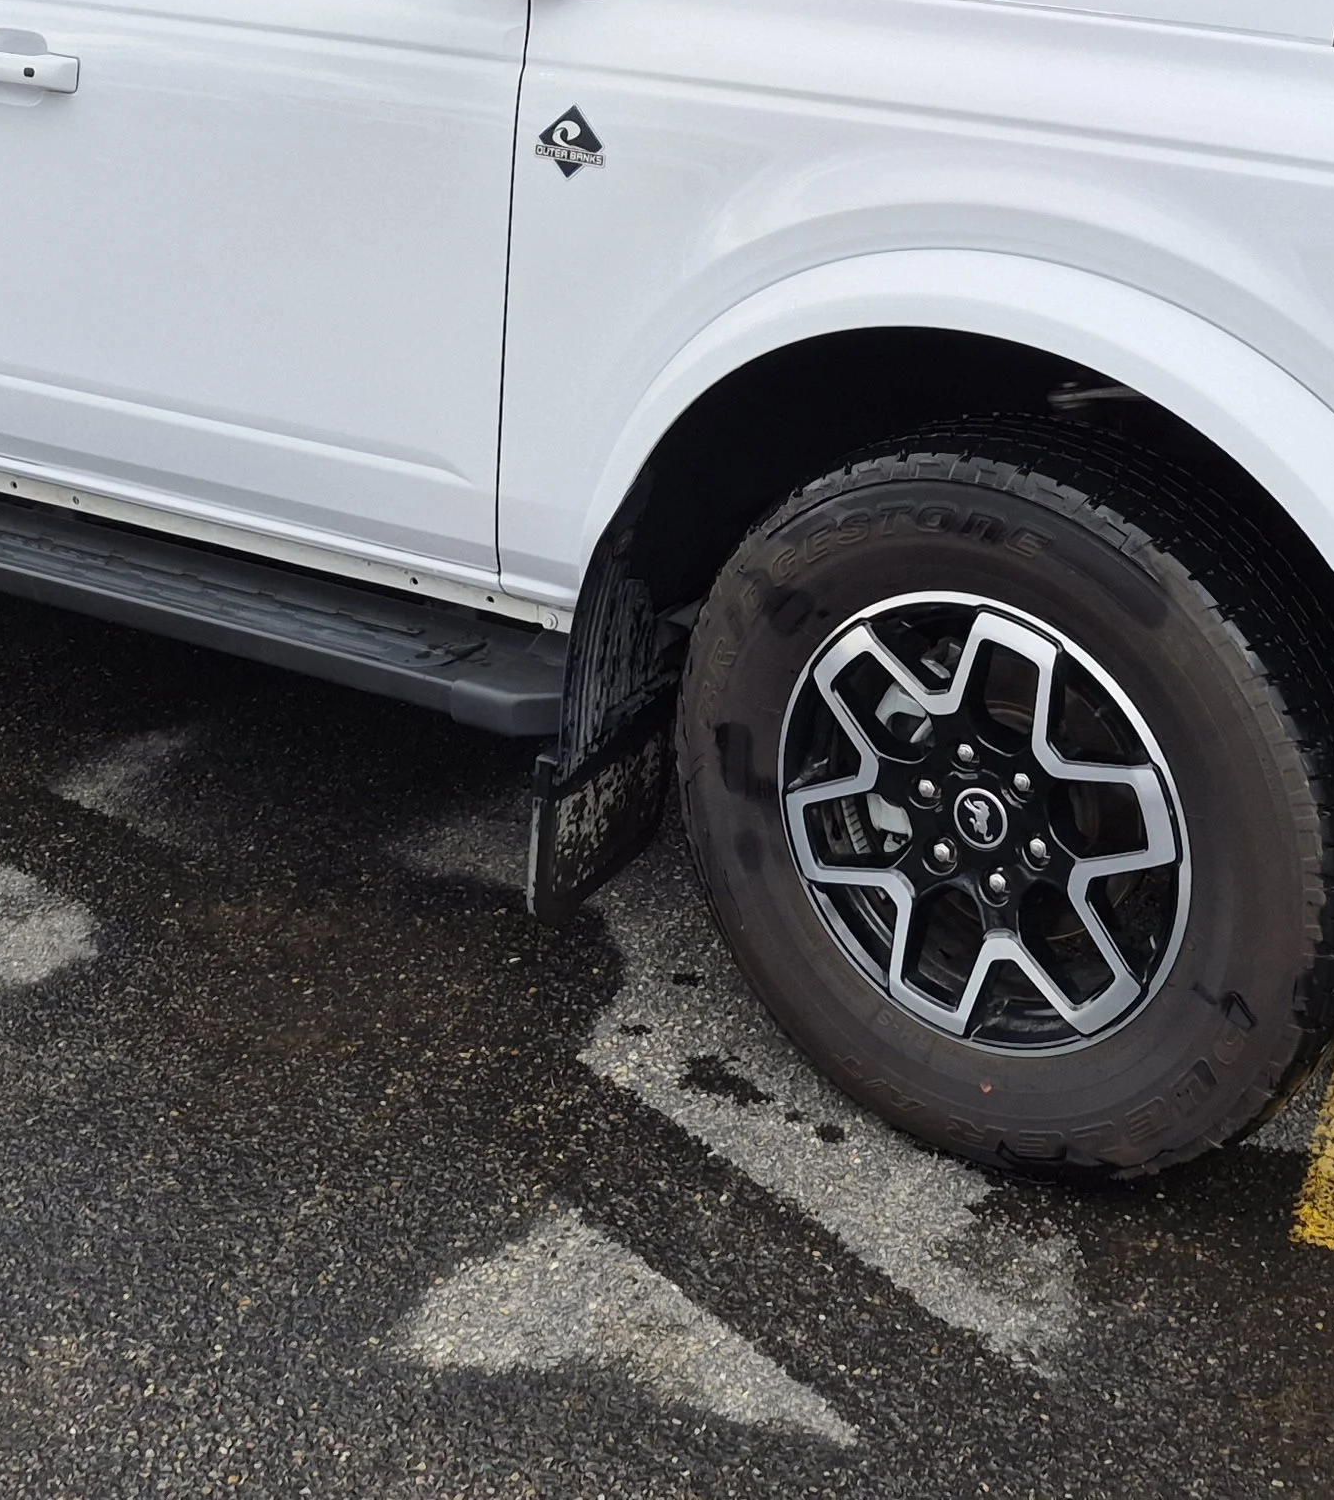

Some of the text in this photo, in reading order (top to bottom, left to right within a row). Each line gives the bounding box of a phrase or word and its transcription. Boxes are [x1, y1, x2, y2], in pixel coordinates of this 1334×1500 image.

[536, 145, 603, 165] OUTER BANKS
[697, 502, 1058, 728] BRIDGESTONE
